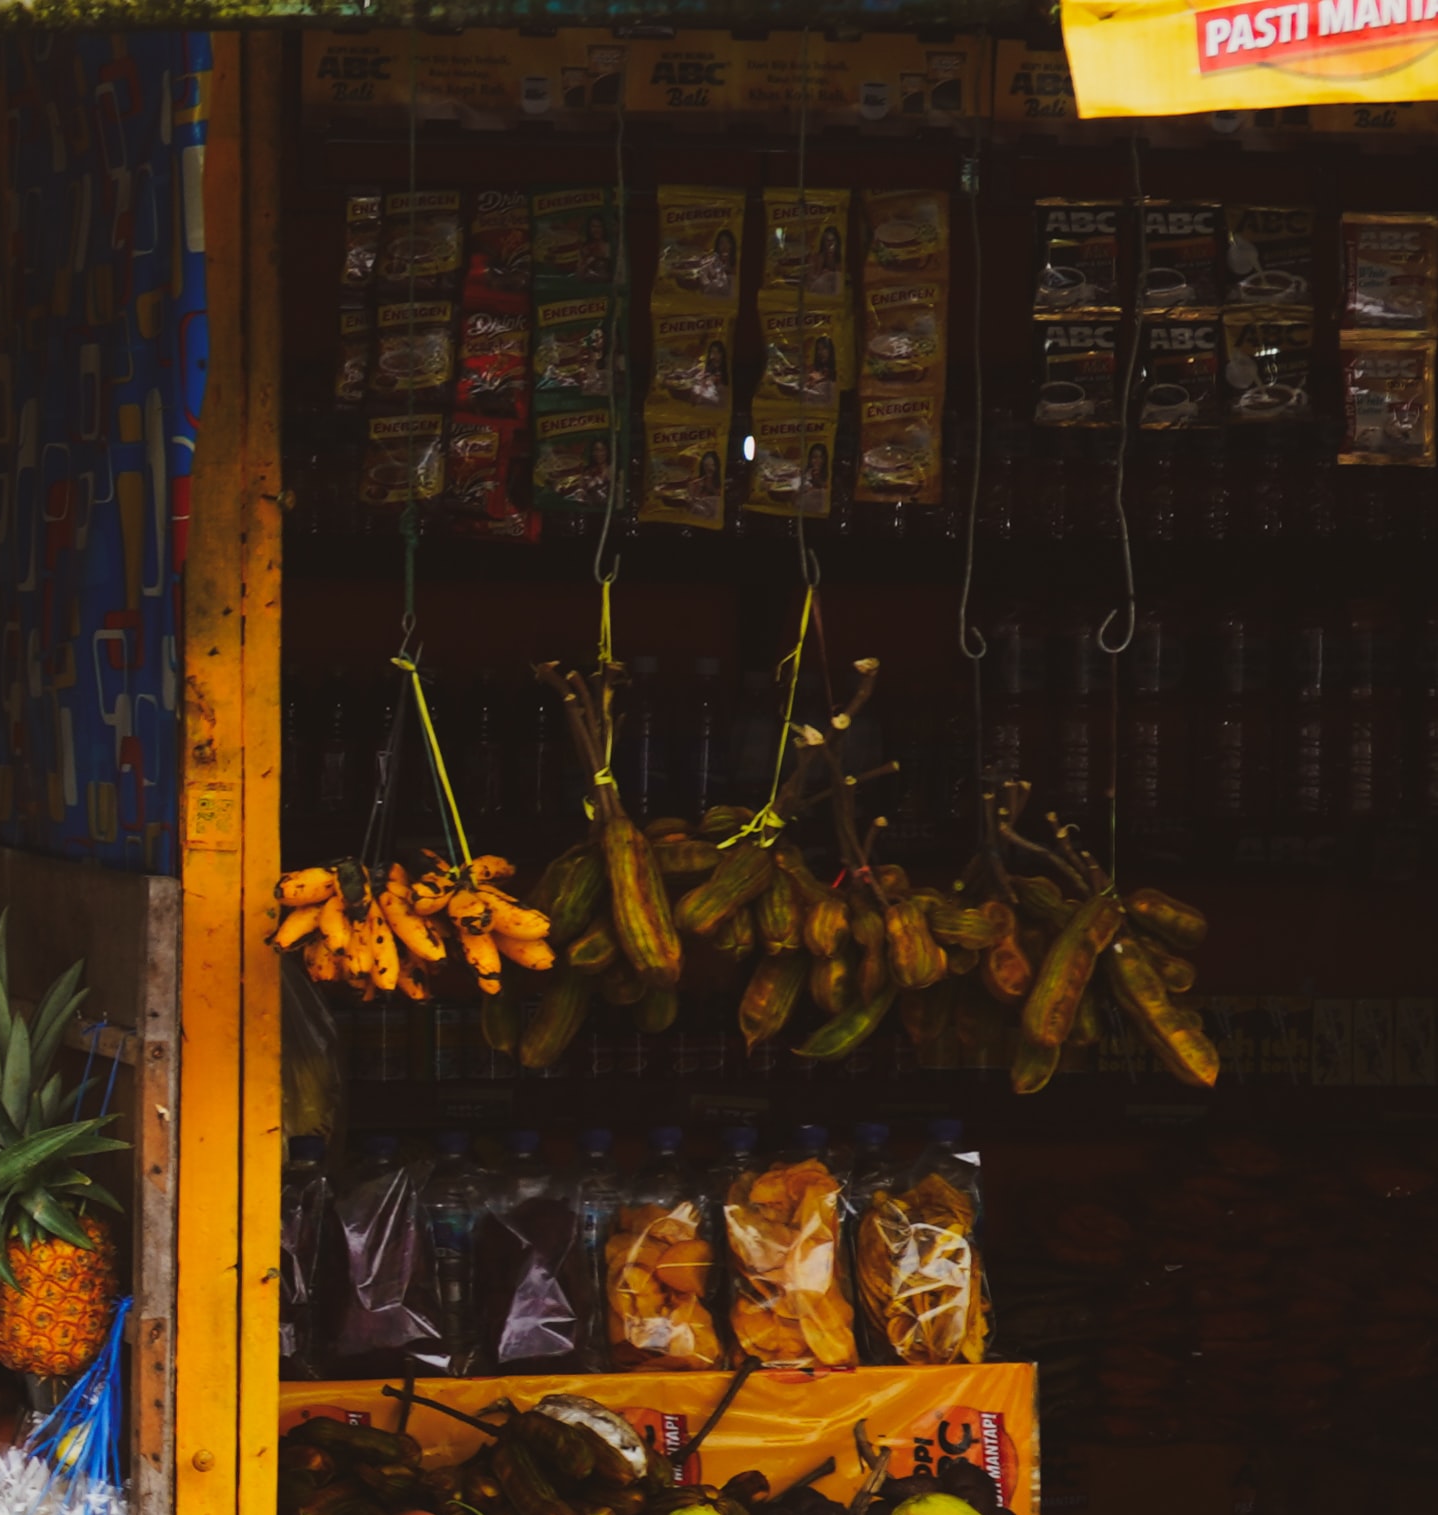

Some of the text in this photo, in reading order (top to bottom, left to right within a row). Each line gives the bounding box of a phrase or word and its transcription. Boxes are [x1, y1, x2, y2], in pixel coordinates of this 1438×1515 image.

[1205, 8, 1308, 57] PASTI
[317, 56, 391, 79] ABC
[651, 61, 726, 85] ABC
[331, 82, 376, 101] Bali
[666, 88, 710, 108] Bali
[1025, 100, 1066, 118] Bali
[1354, 110, 1396, 128] Bali
[667, 207, 732, 224] ENERGEN
[1046, 211, 1116, 233] ABC
[1145, 211, 1214, 234] ABC
[1236, 209, 1308, 234] ABC
[871, 288, 935, 305] ENERGEN
[543, 303, 606, 320] ENERGEN
[659, 318, 724, 334] ENERGEN
[1046, 326, 1114, 348] ABC
[1150, 327, 1215, 350] ABC
[867, 401, 929, 417] ENERGEN
[541, 414, 606, 433] ENERGEN
[653, 429, 716, 445] ENERGEN
